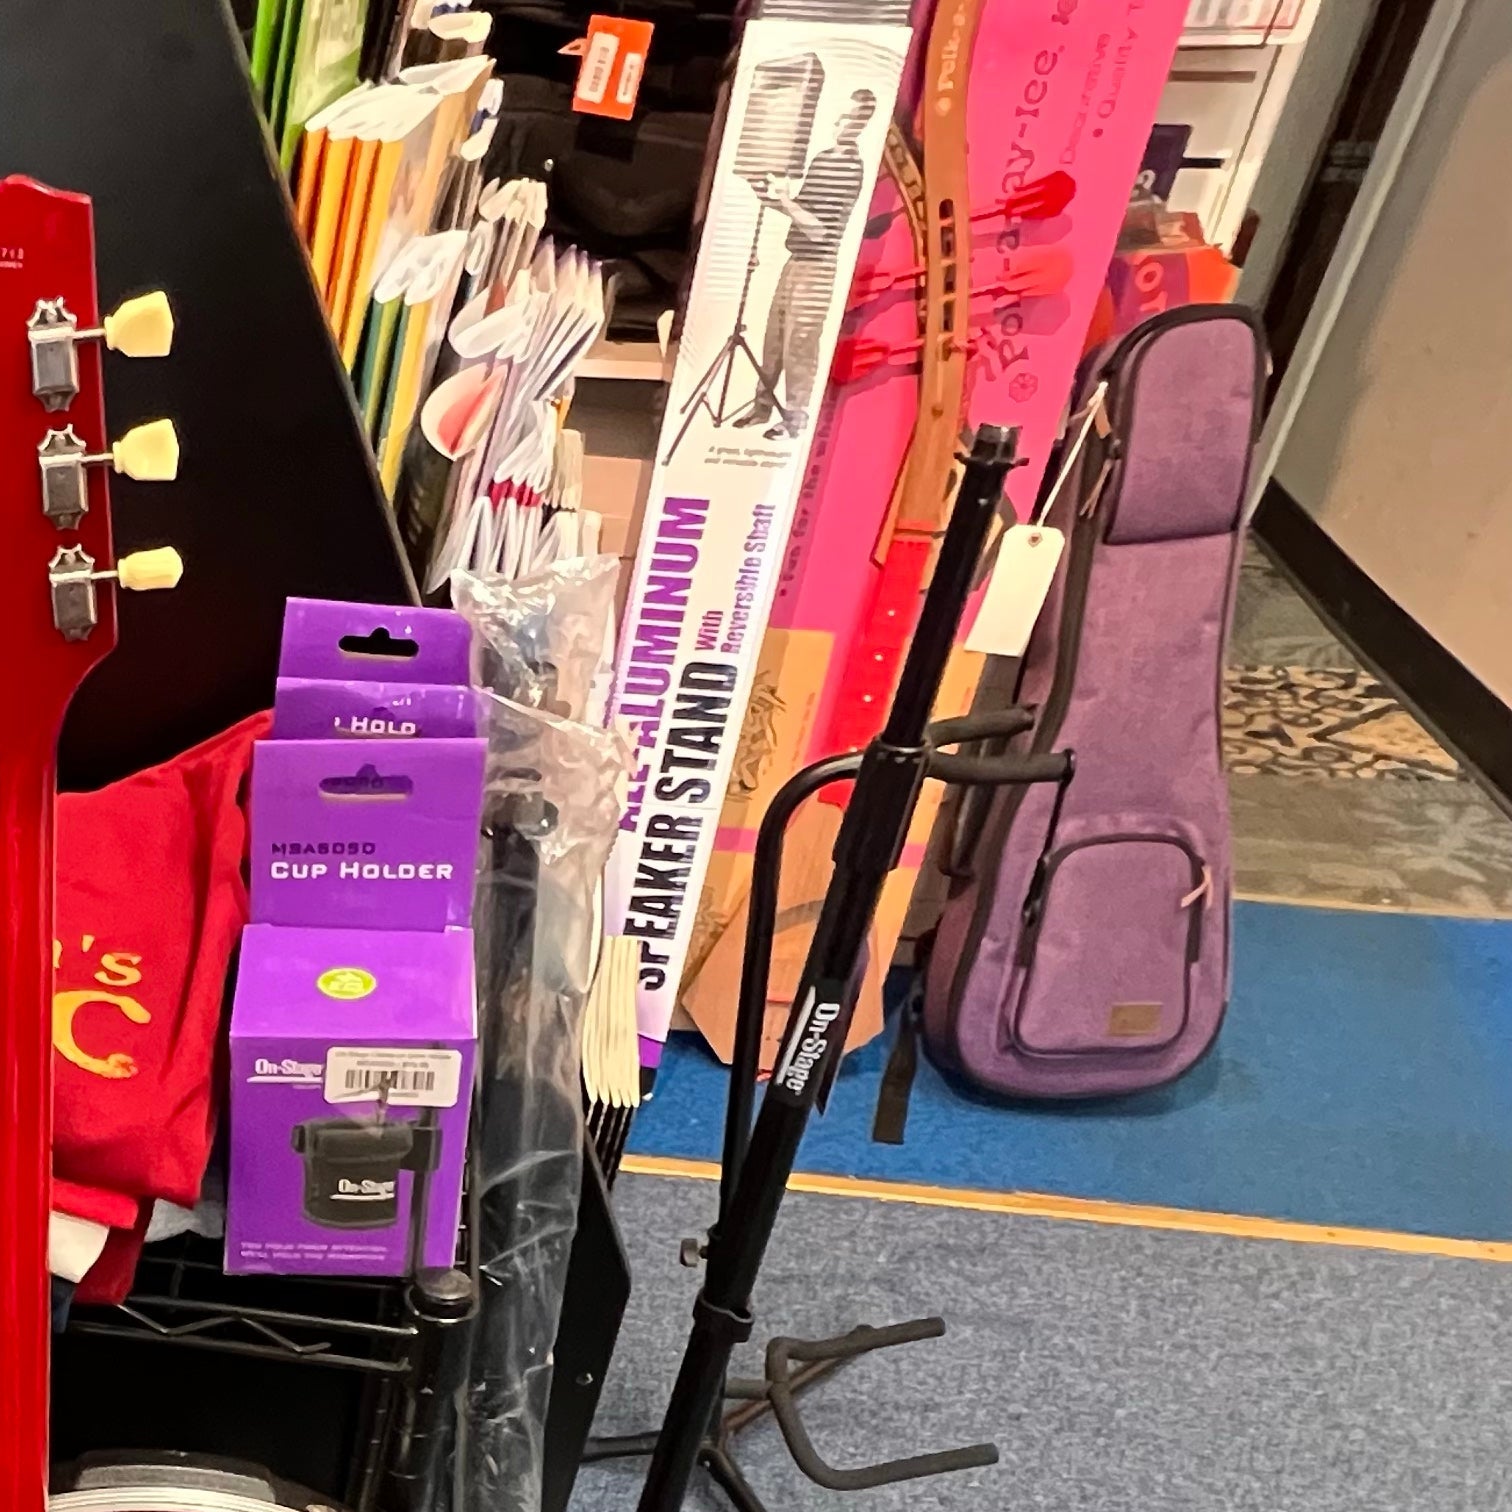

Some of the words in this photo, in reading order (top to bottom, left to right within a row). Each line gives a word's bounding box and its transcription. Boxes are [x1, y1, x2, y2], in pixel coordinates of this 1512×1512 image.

[744, 504, 776, 553] Shaft
[695, 611, 723, 652] With
[654, 662, 738, 804] STAND
[786, 1003, 840, 1096] On-Stage
